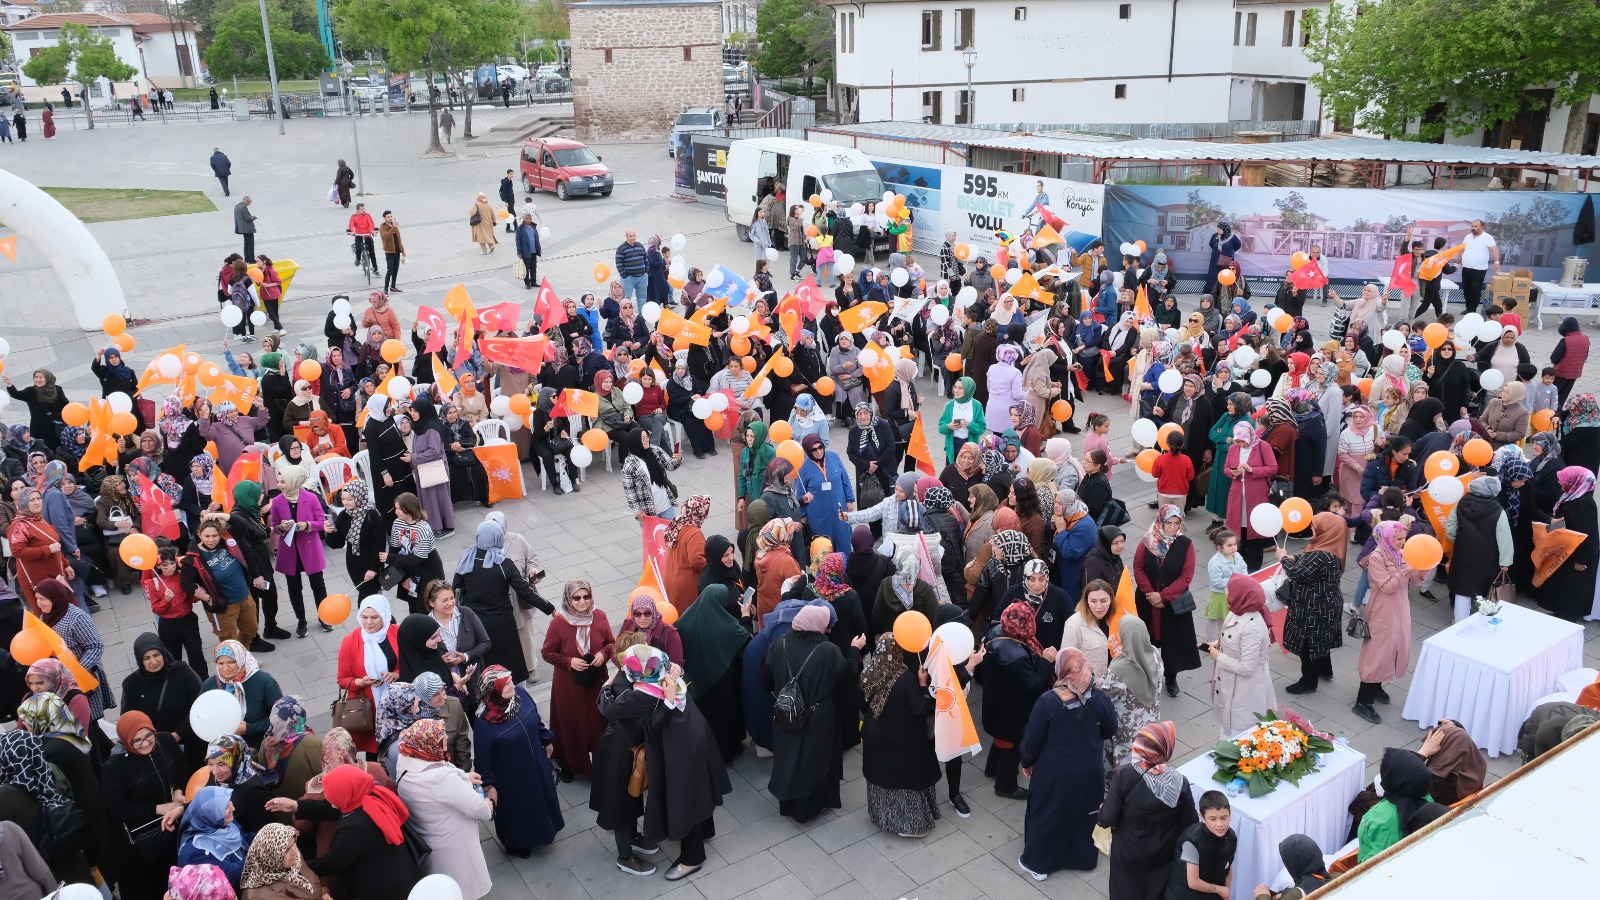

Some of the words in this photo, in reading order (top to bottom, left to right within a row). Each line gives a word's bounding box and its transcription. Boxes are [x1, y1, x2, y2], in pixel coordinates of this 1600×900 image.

[963, 173, 998, 198] 595
[998, 190, 1009, 200] KM
[957, 194, 1015, 218] BİSİKLET
[1066, 196, 1095, 217] Konya
[968, 212, 1003, 231] YOLU
